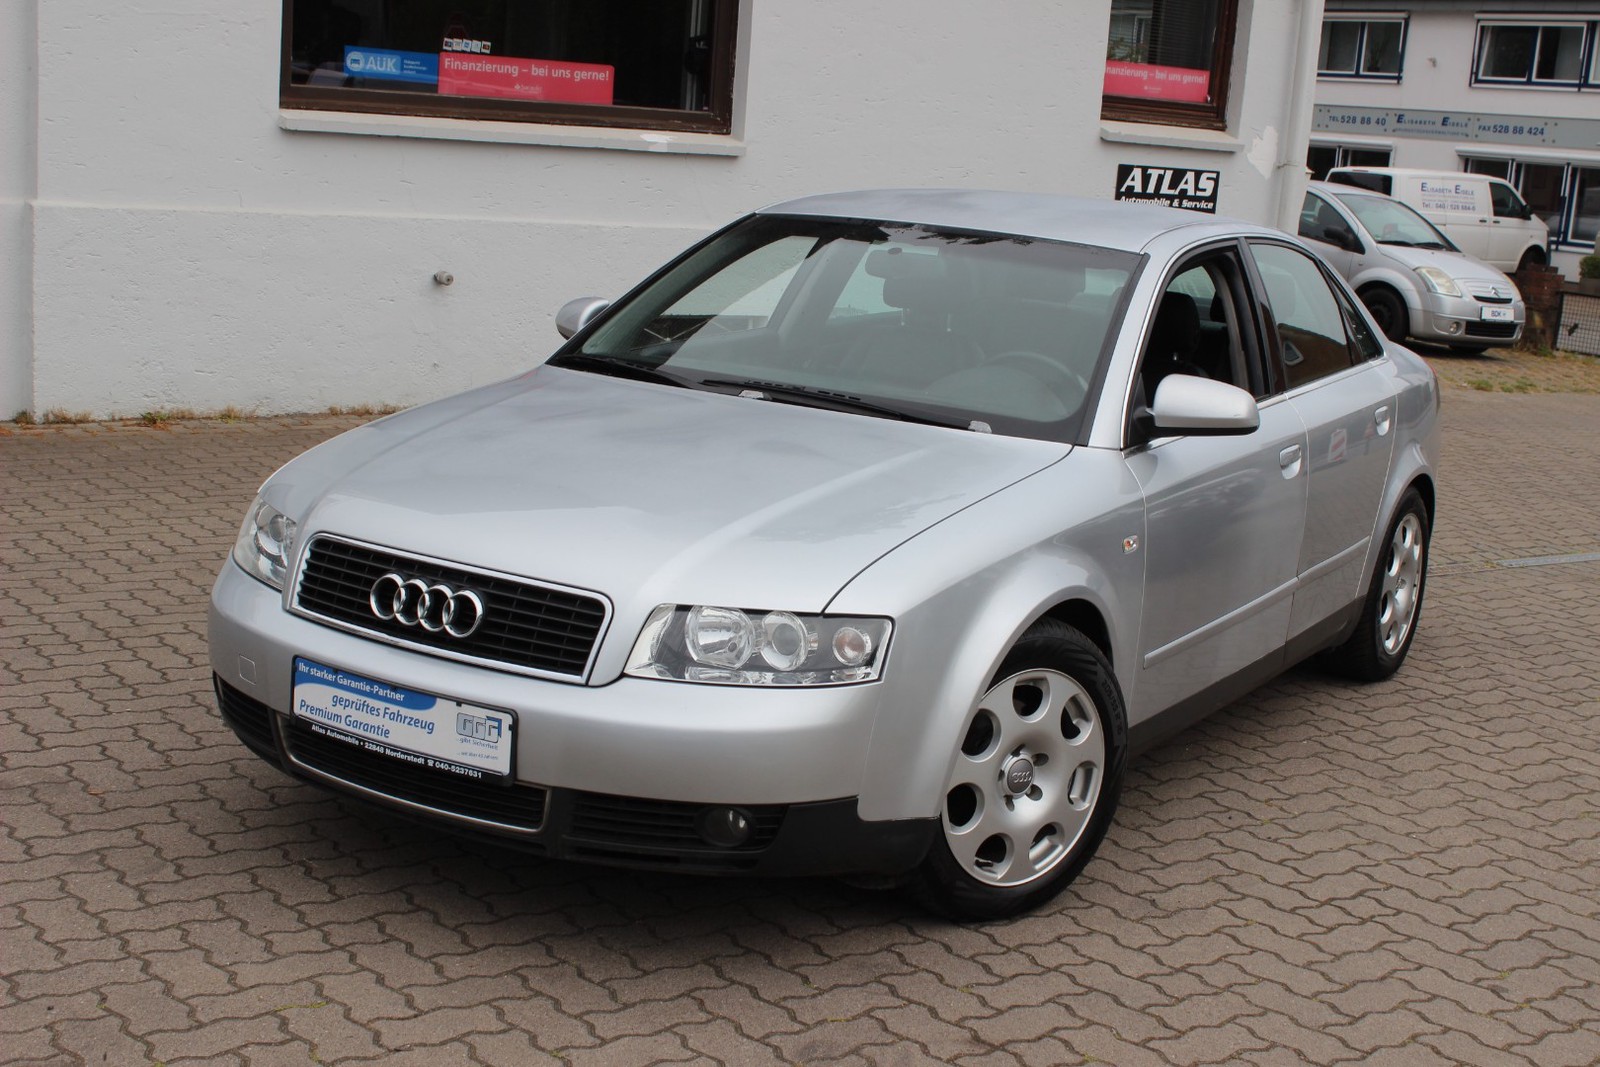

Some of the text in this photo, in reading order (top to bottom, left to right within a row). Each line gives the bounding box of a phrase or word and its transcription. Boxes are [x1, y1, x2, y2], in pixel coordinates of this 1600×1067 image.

[444, 58, 519, 76] Finanzierung
[531, 64, 548, 76] bei
[551, 69, 571, 78] uns
[574, 70, 609, 82] gerne!
[1155, 69, 1167, 79] bei
[1168, 73, 1181, 81] uns
[1182, 74, 1206, 84] gerne!
[1340, 115, 1357, 124] 528
[1360, 116, 1371, 125] 88
[1375, 117, 1386, 126] 40
[1492, 124, 1509, 134] 528
[1512, 125, 1524, 135] 88
[1527, 127, 1545, 136] 424
[1119, 167, 1217, 197] ATLAS
[1120, 196, 1214, 210] Automobile & Service
[298, 662, 405, 701] Ihr starker Garantie-Partner
[299, 699, 391, 739] Premium Garantie
[332, 694, 435, 735] geprüftes Fahrzeug
[311, 724, 326, 734] Atlas
[326, 728, 360, 746] Automobile
[385, 748, 425, 765] Norderstedt
